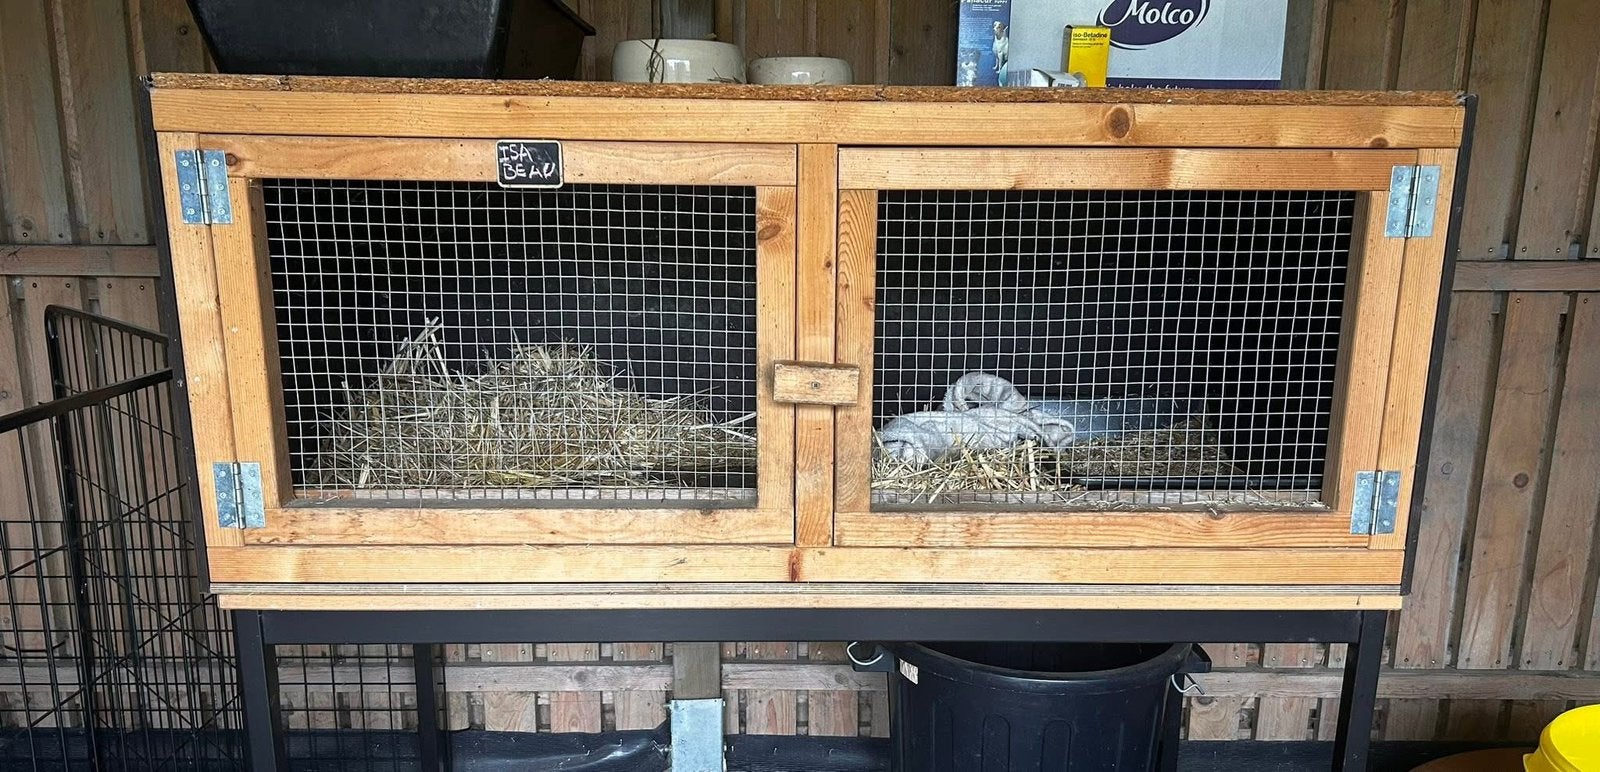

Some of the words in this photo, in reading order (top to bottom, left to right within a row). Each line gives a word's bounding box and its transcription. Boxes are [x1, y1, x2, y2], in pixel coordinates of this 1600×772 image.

[1100, 0, 1194, 26] Molco
[498, 143, 535, 163] ISA
[503, 162, 556, 180] BEAU
